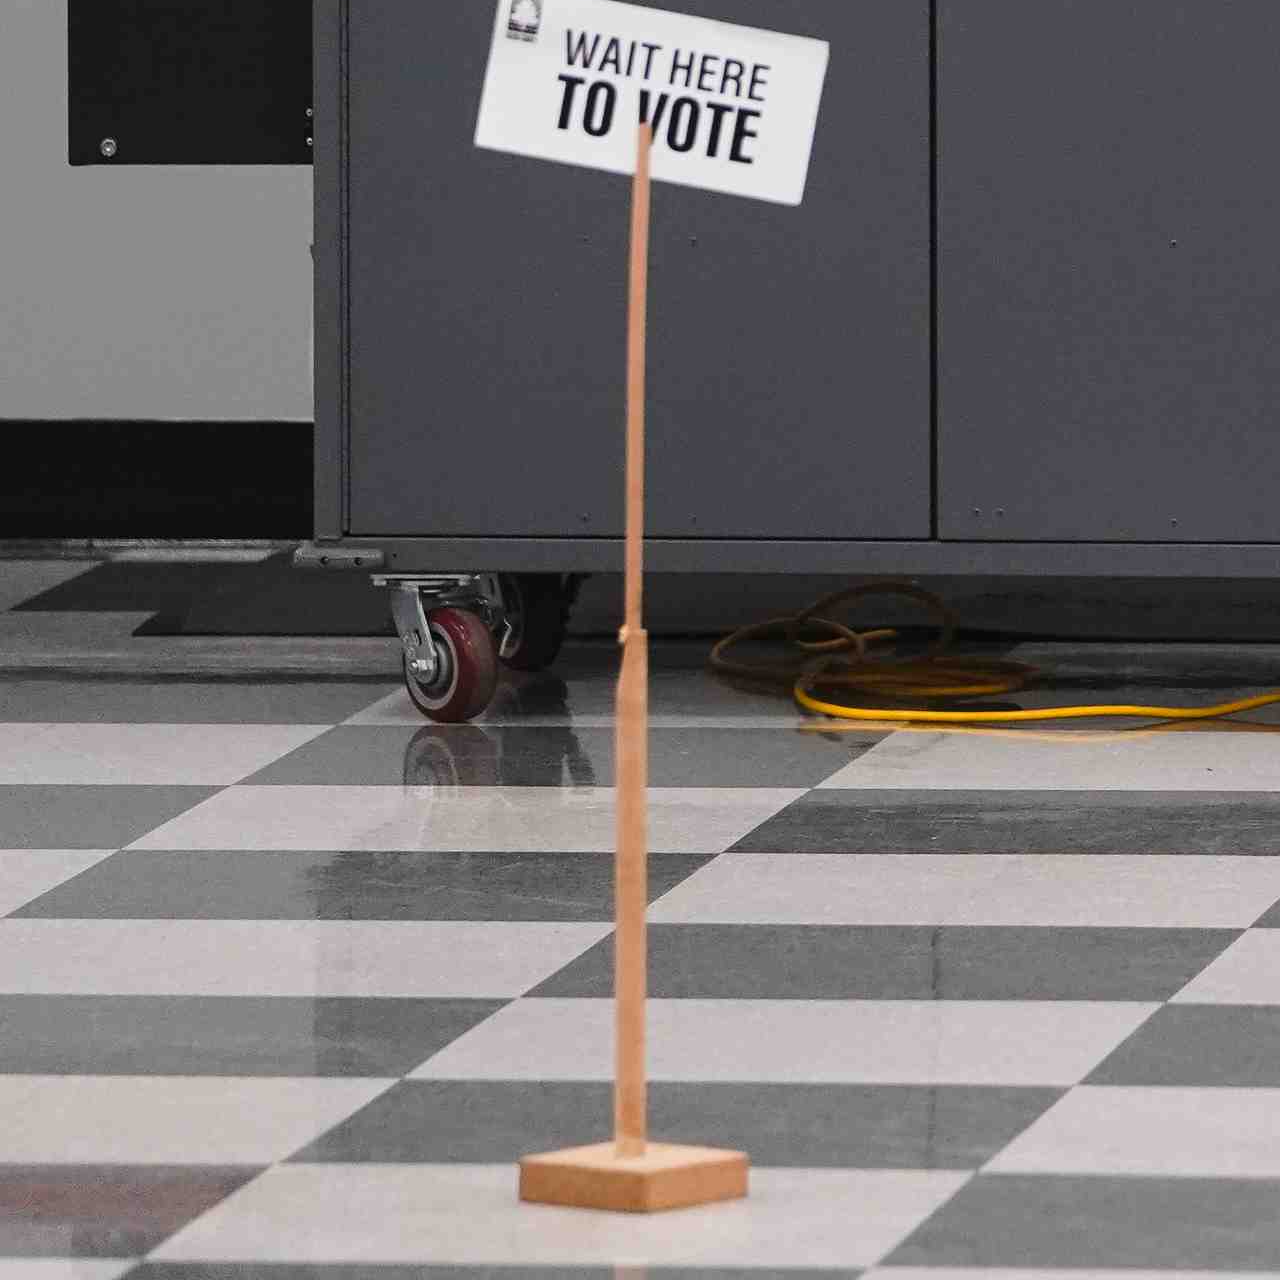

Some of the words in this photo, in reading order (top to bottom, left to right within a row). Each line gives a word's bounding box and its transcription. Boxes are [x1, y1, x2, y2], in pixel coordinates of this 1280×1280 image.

[565, 28, 663, 80] WAIT
[668, 48, 771, 102] HERE
[556, 73, 617, 138] TO
[638, 88, 763, 164] VOTE
